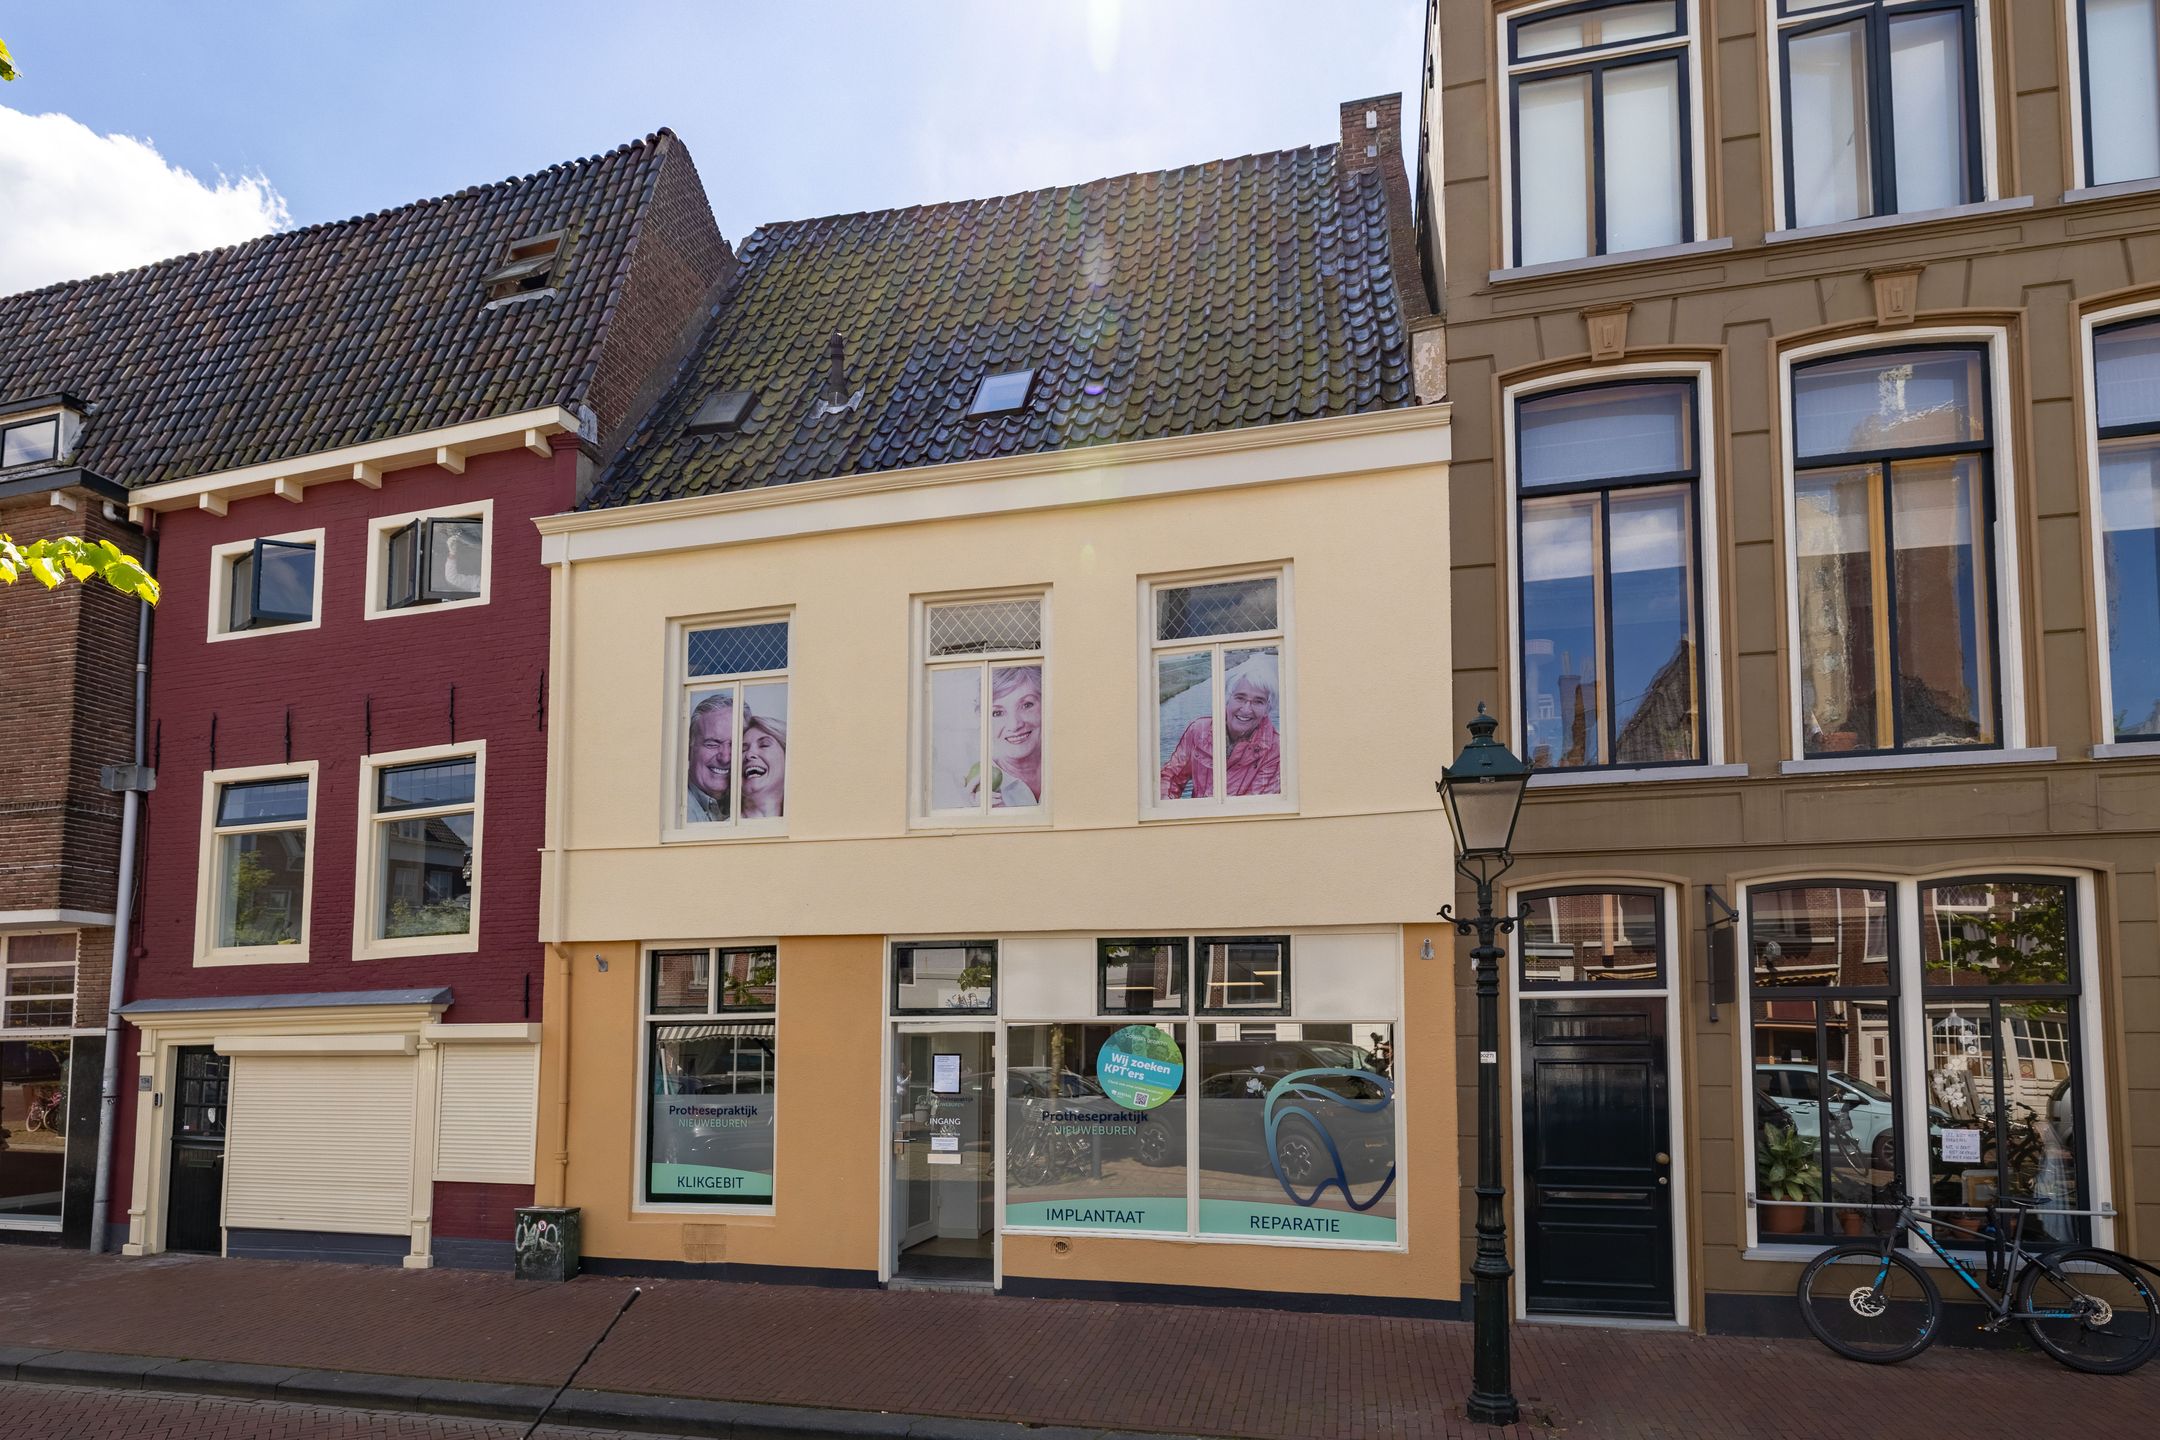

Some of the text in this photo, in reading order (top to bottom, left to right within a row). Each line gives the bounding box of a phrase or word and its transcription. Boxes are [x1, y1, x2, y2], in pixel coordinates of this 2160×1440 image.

[1111, 1052, 1171, 1075] Wij zoeken
[1104, 1063, 1145, 1081] KPT'ers
[669, 1105, 758, 1118] Prothesepraktijk
[1042, 1110, 1149, 1125] Prothesepraktijk
[679, 1118, 748, 1128] NIEUWEBUREN
[929, 1117, 961, 1125] INGANG
[1054, 1125, 1137, 1136] NIEUWEBUREN
[677, 1175, 745, 1189] KLIKGEBIT
[1046, 1207, 1145, 1224] IMPLANTAAT
[1250, 1215, 1340, 1233] REPARATIE
